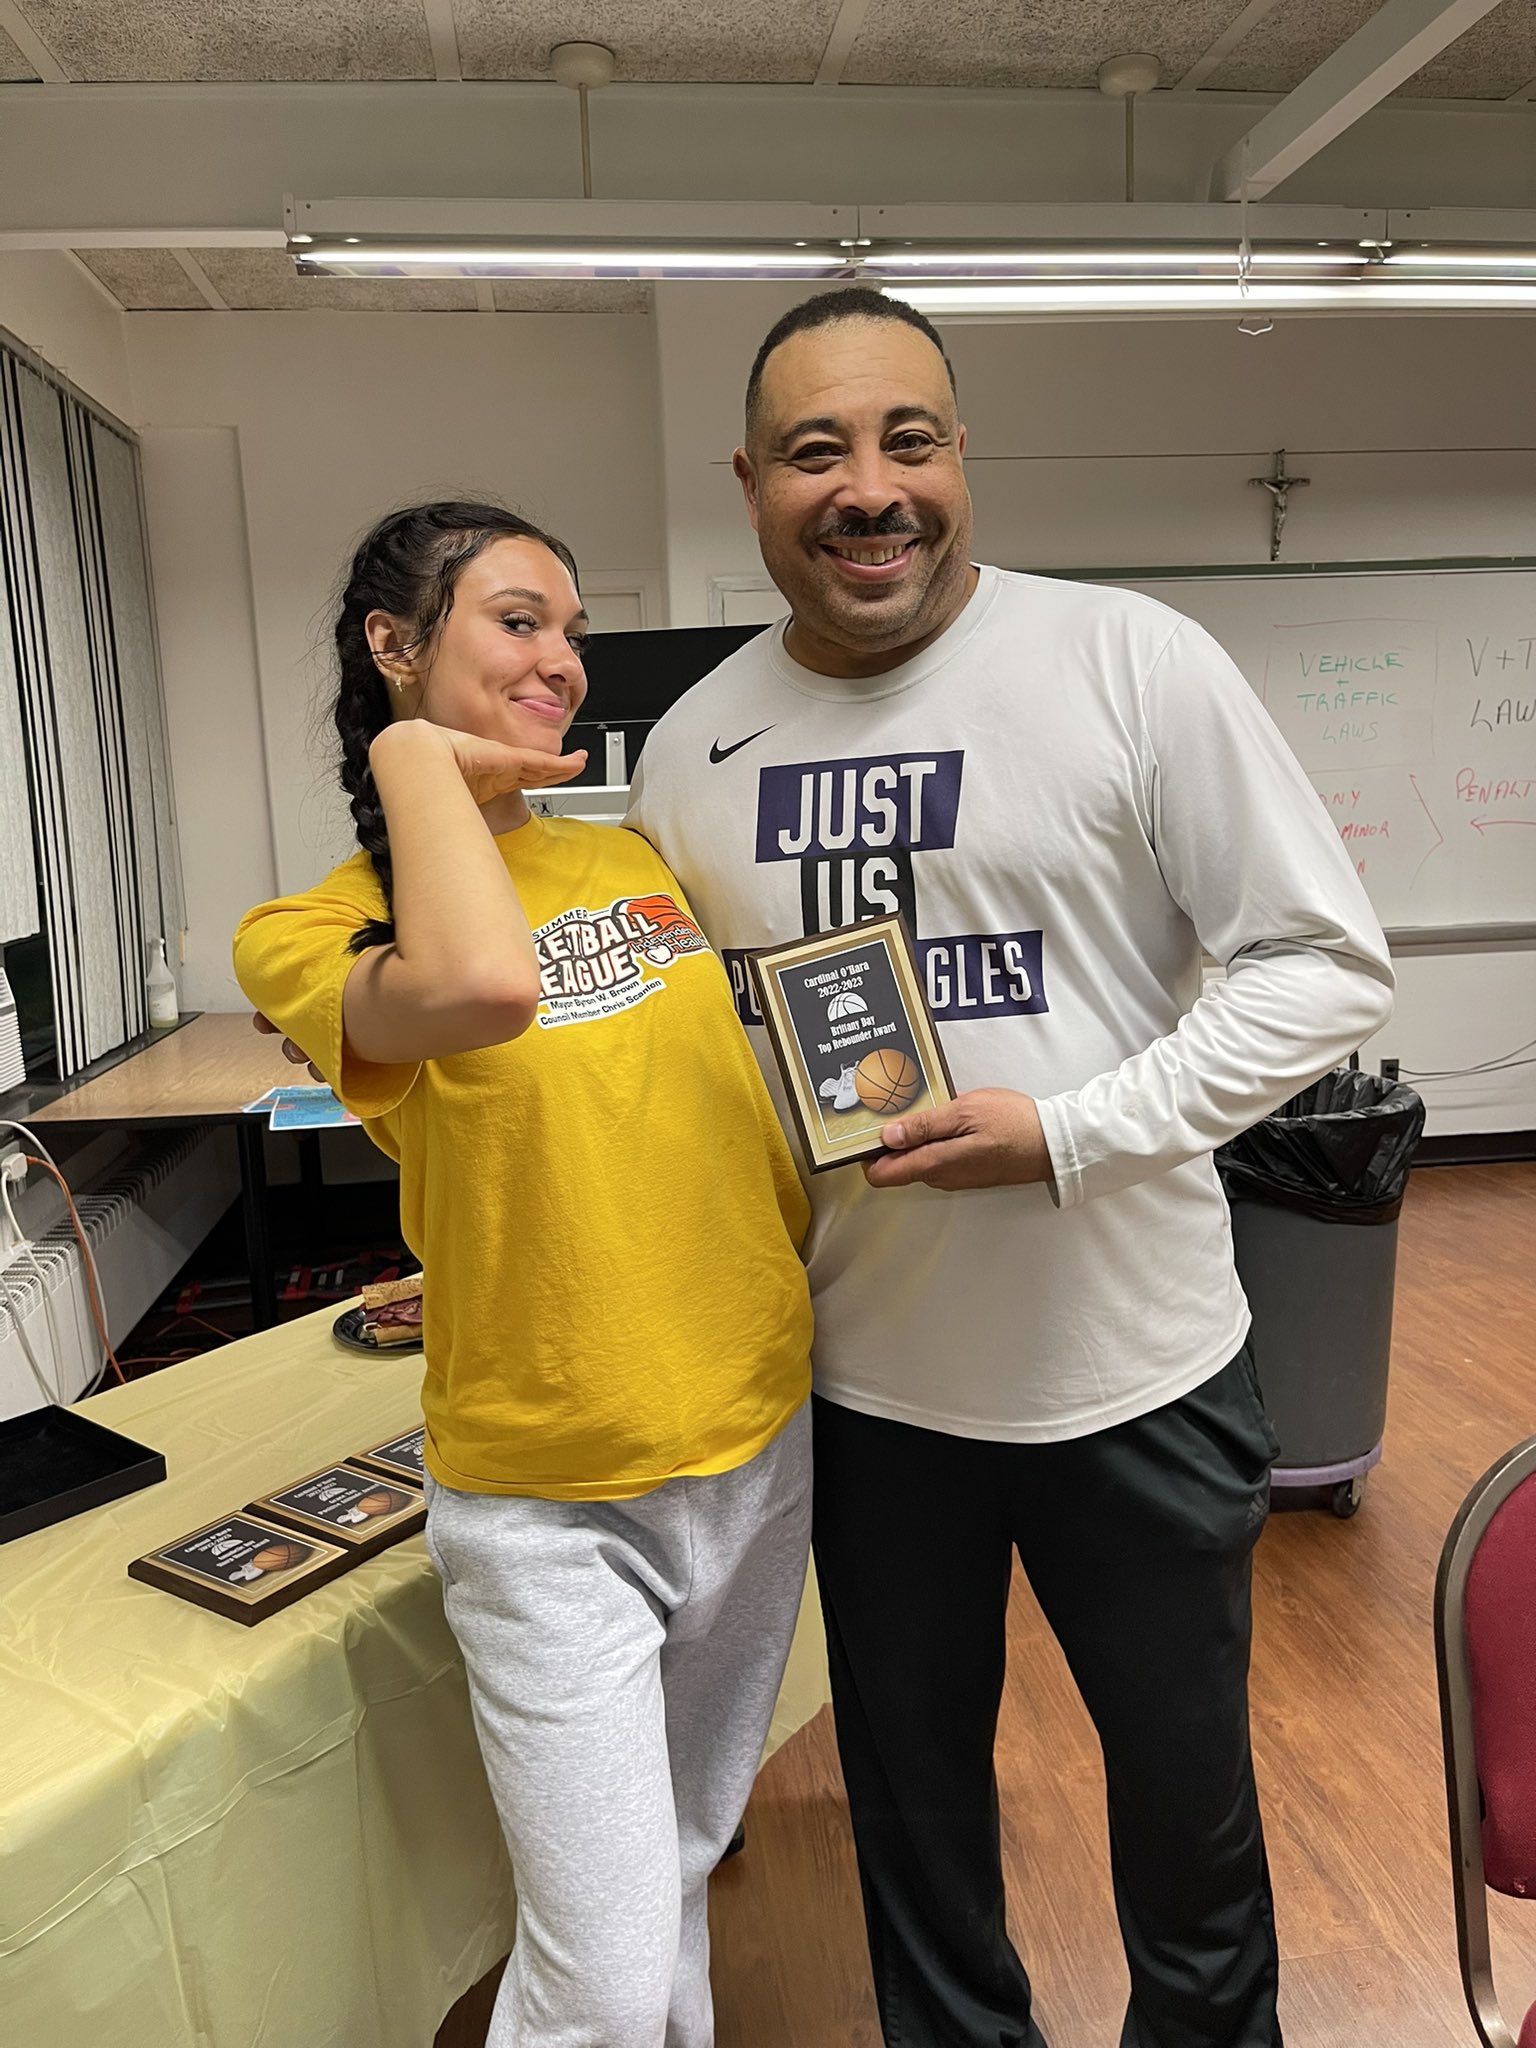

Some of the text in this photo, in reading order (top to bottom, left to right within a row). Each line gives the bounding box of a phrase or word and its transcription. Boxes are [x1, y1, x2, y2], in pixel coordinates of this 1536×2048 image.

[1299, 652, 1404, 677] VEHICLE
[1297, 691, 1400, 712] TRAFFIC
[1322, 721, 1379, 744] LAWS
[777, 760, 938, 855] JUST
[816, 856, 899, 934] US
[532, 909, 589, 940] SUMMER
[539, 944, 638, 1000] EAGUE
[803, 961, 870, 988] Cardinal O'Hara
[817, 976, 864, 998] 2022-2023
[540, 980, 662, 1026] Council Member Chris Scanlon
[550, 980, 640, 1011] Mayor Byron W. Brown
[817, 1021, 897, 1054] Top Rebounder Award
[830, 1015, 876, 1037] Brittany Day
